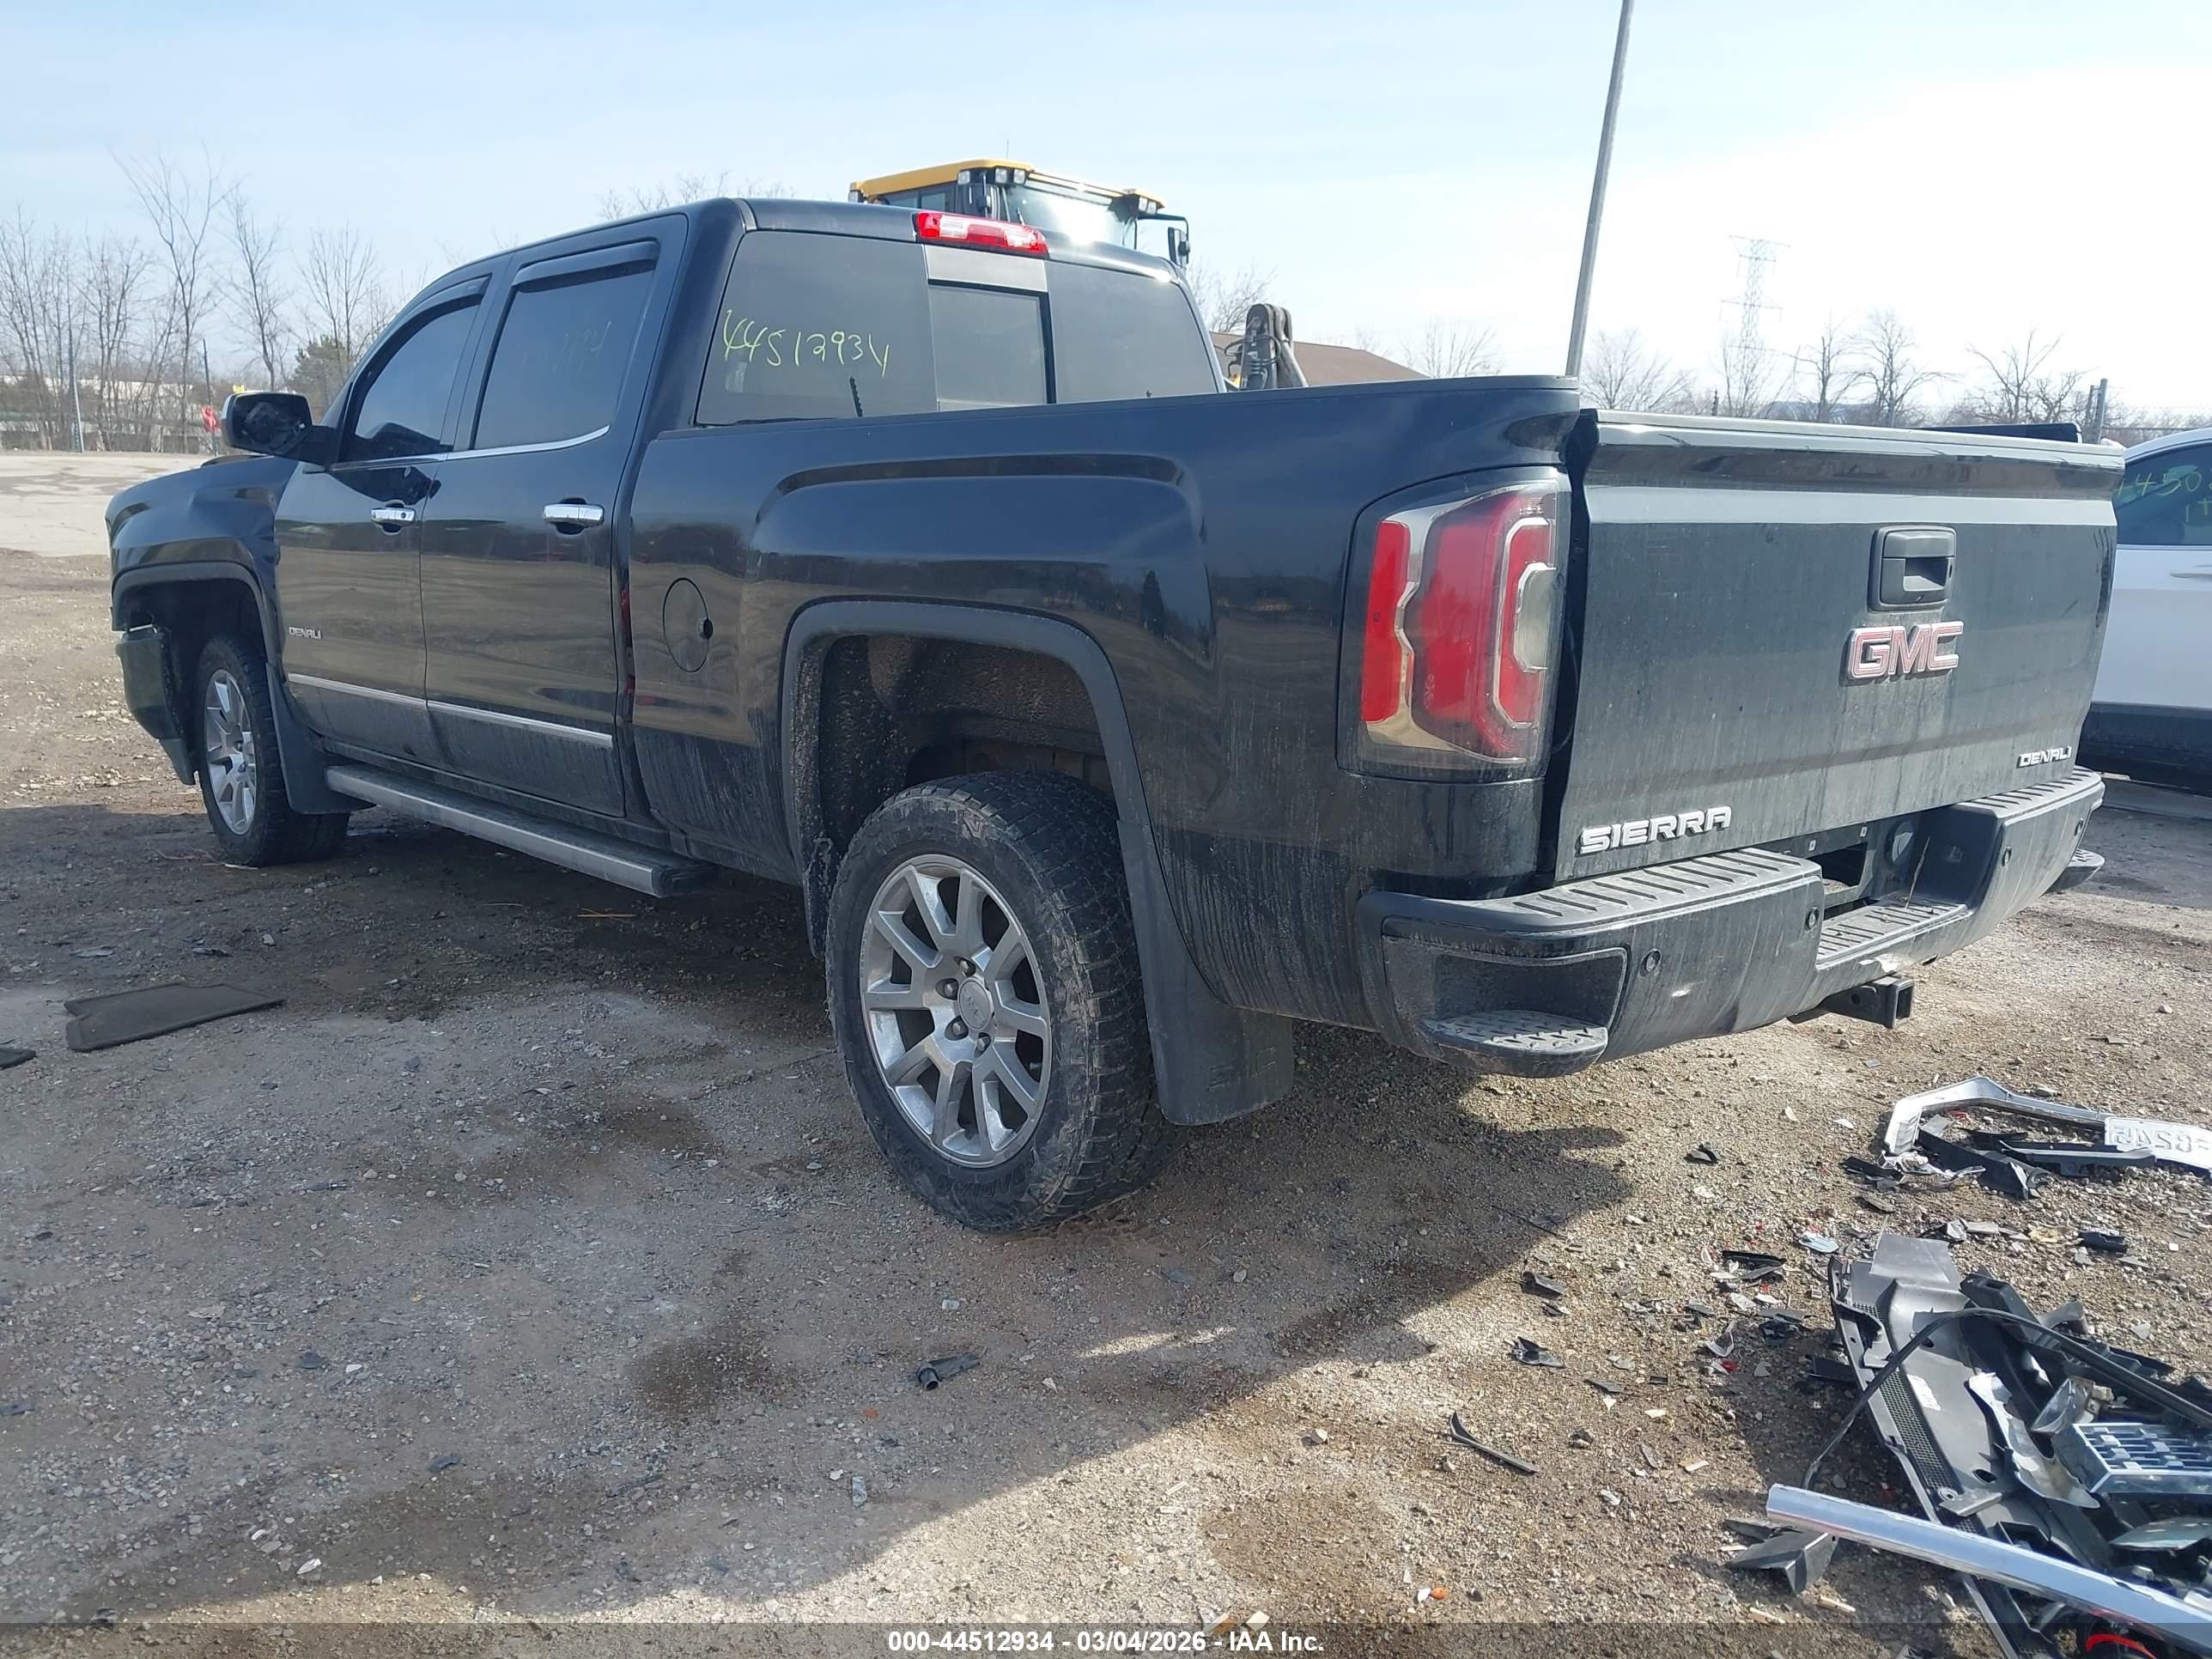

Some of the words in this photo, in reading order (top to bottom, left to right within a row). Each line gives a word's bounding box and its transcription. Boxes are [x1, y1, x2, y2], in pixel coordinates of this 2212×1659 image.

[289, 626, 322, 640] DENALI
[1848, 621, 1964, 678] GMC
[2017, 745, 2072, 768] DENALI
[1578, 805, 1732, 855] SIERRA
